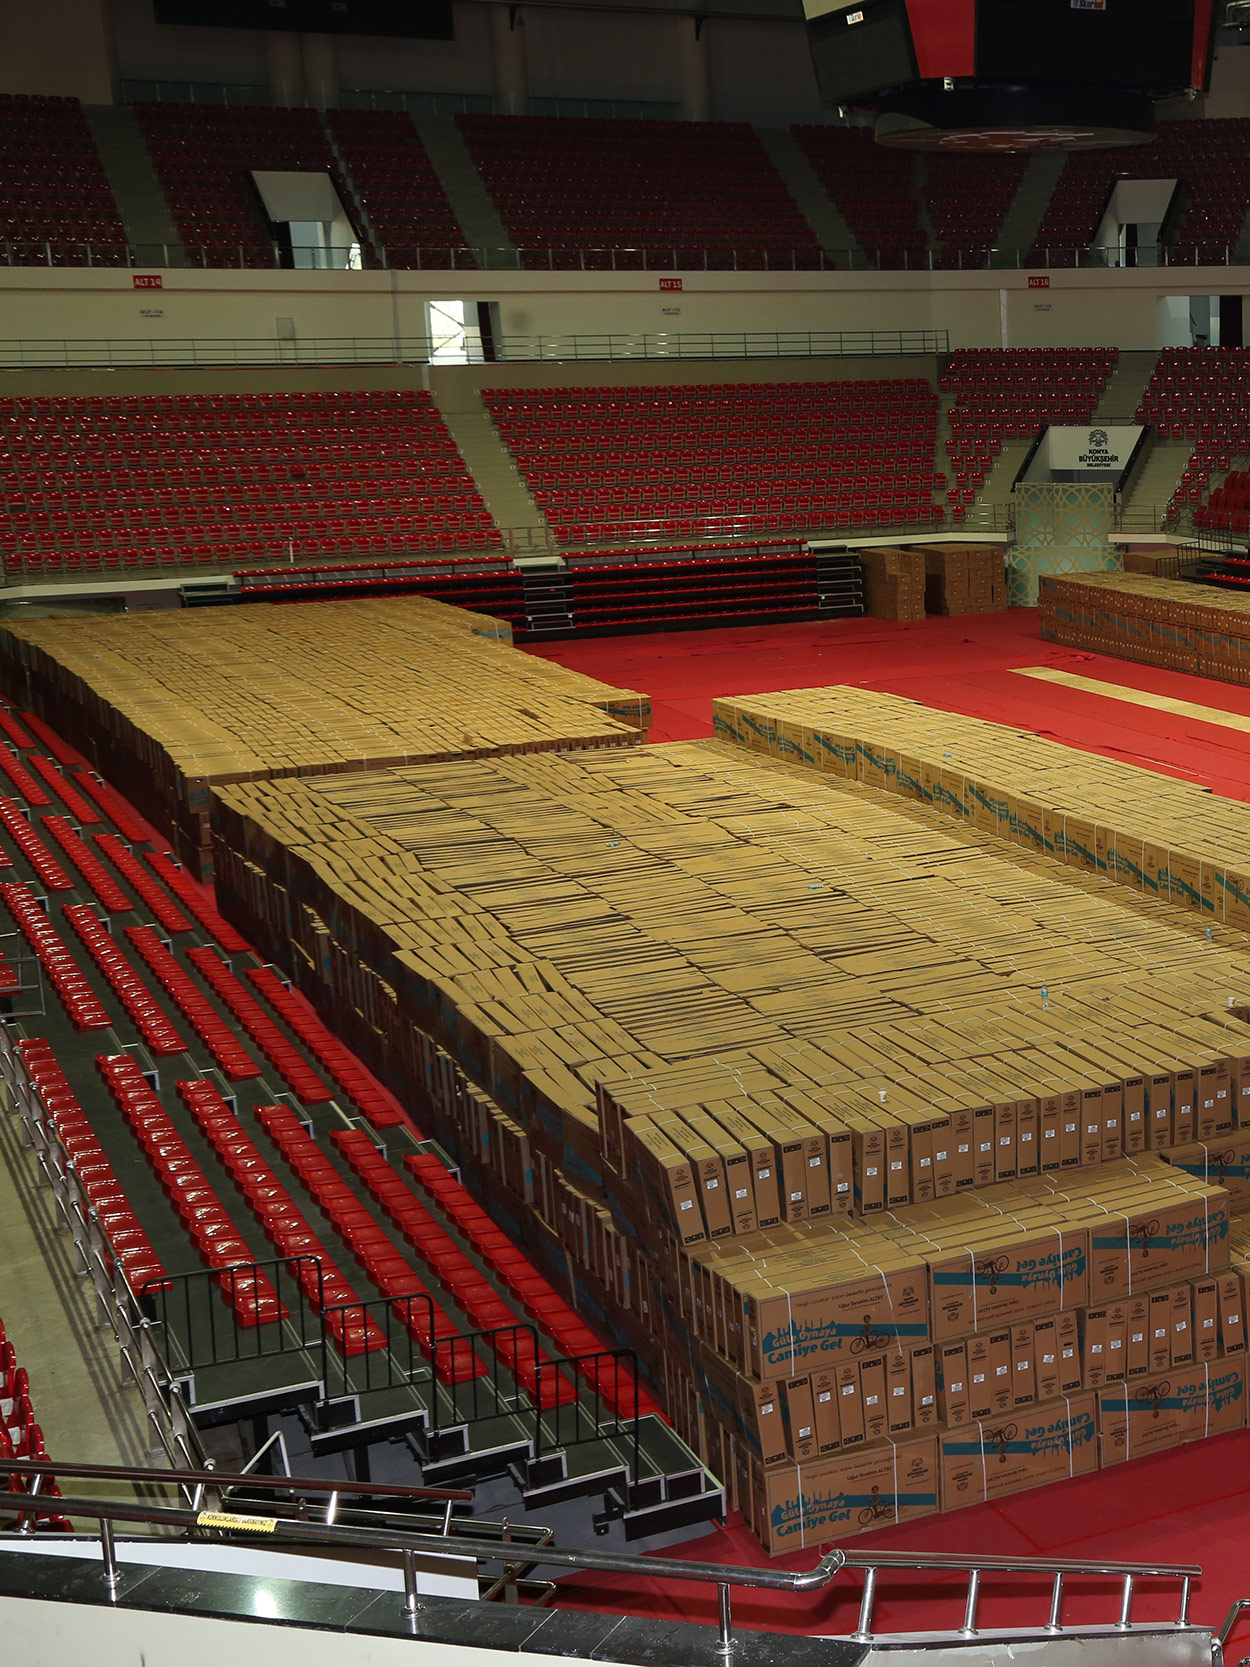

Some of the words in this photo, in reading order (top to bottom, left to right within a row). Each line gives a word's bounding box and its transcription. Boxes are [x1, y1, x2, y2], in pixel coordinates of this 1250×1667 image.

[134, 278, 149, 286] ALT
[660, 280, 672, 289] ALT
[1079, 454, 1119, 463] BÜYÜKŞEHİR
[1166, 1223, 1185, 1235] Gel
[1038, 1246, 1083, 1266] Camiye
[1016, 1258, 1037, 1272] Gel
[799, 1328, 837, 1341] Oynaya
[767, 1344, 818, 1364] Camiye
[820, 1338, 844, 1352] Gel
[1176, 1384, 1197, 1397] Gel
[1047, 1412, 1091, 1434] Camiye
[1024, 1426, 1046, 1440] Gel
[776, 1515, 827, 1537] Camiye
[829, 1508, 852, 1522] Gel
